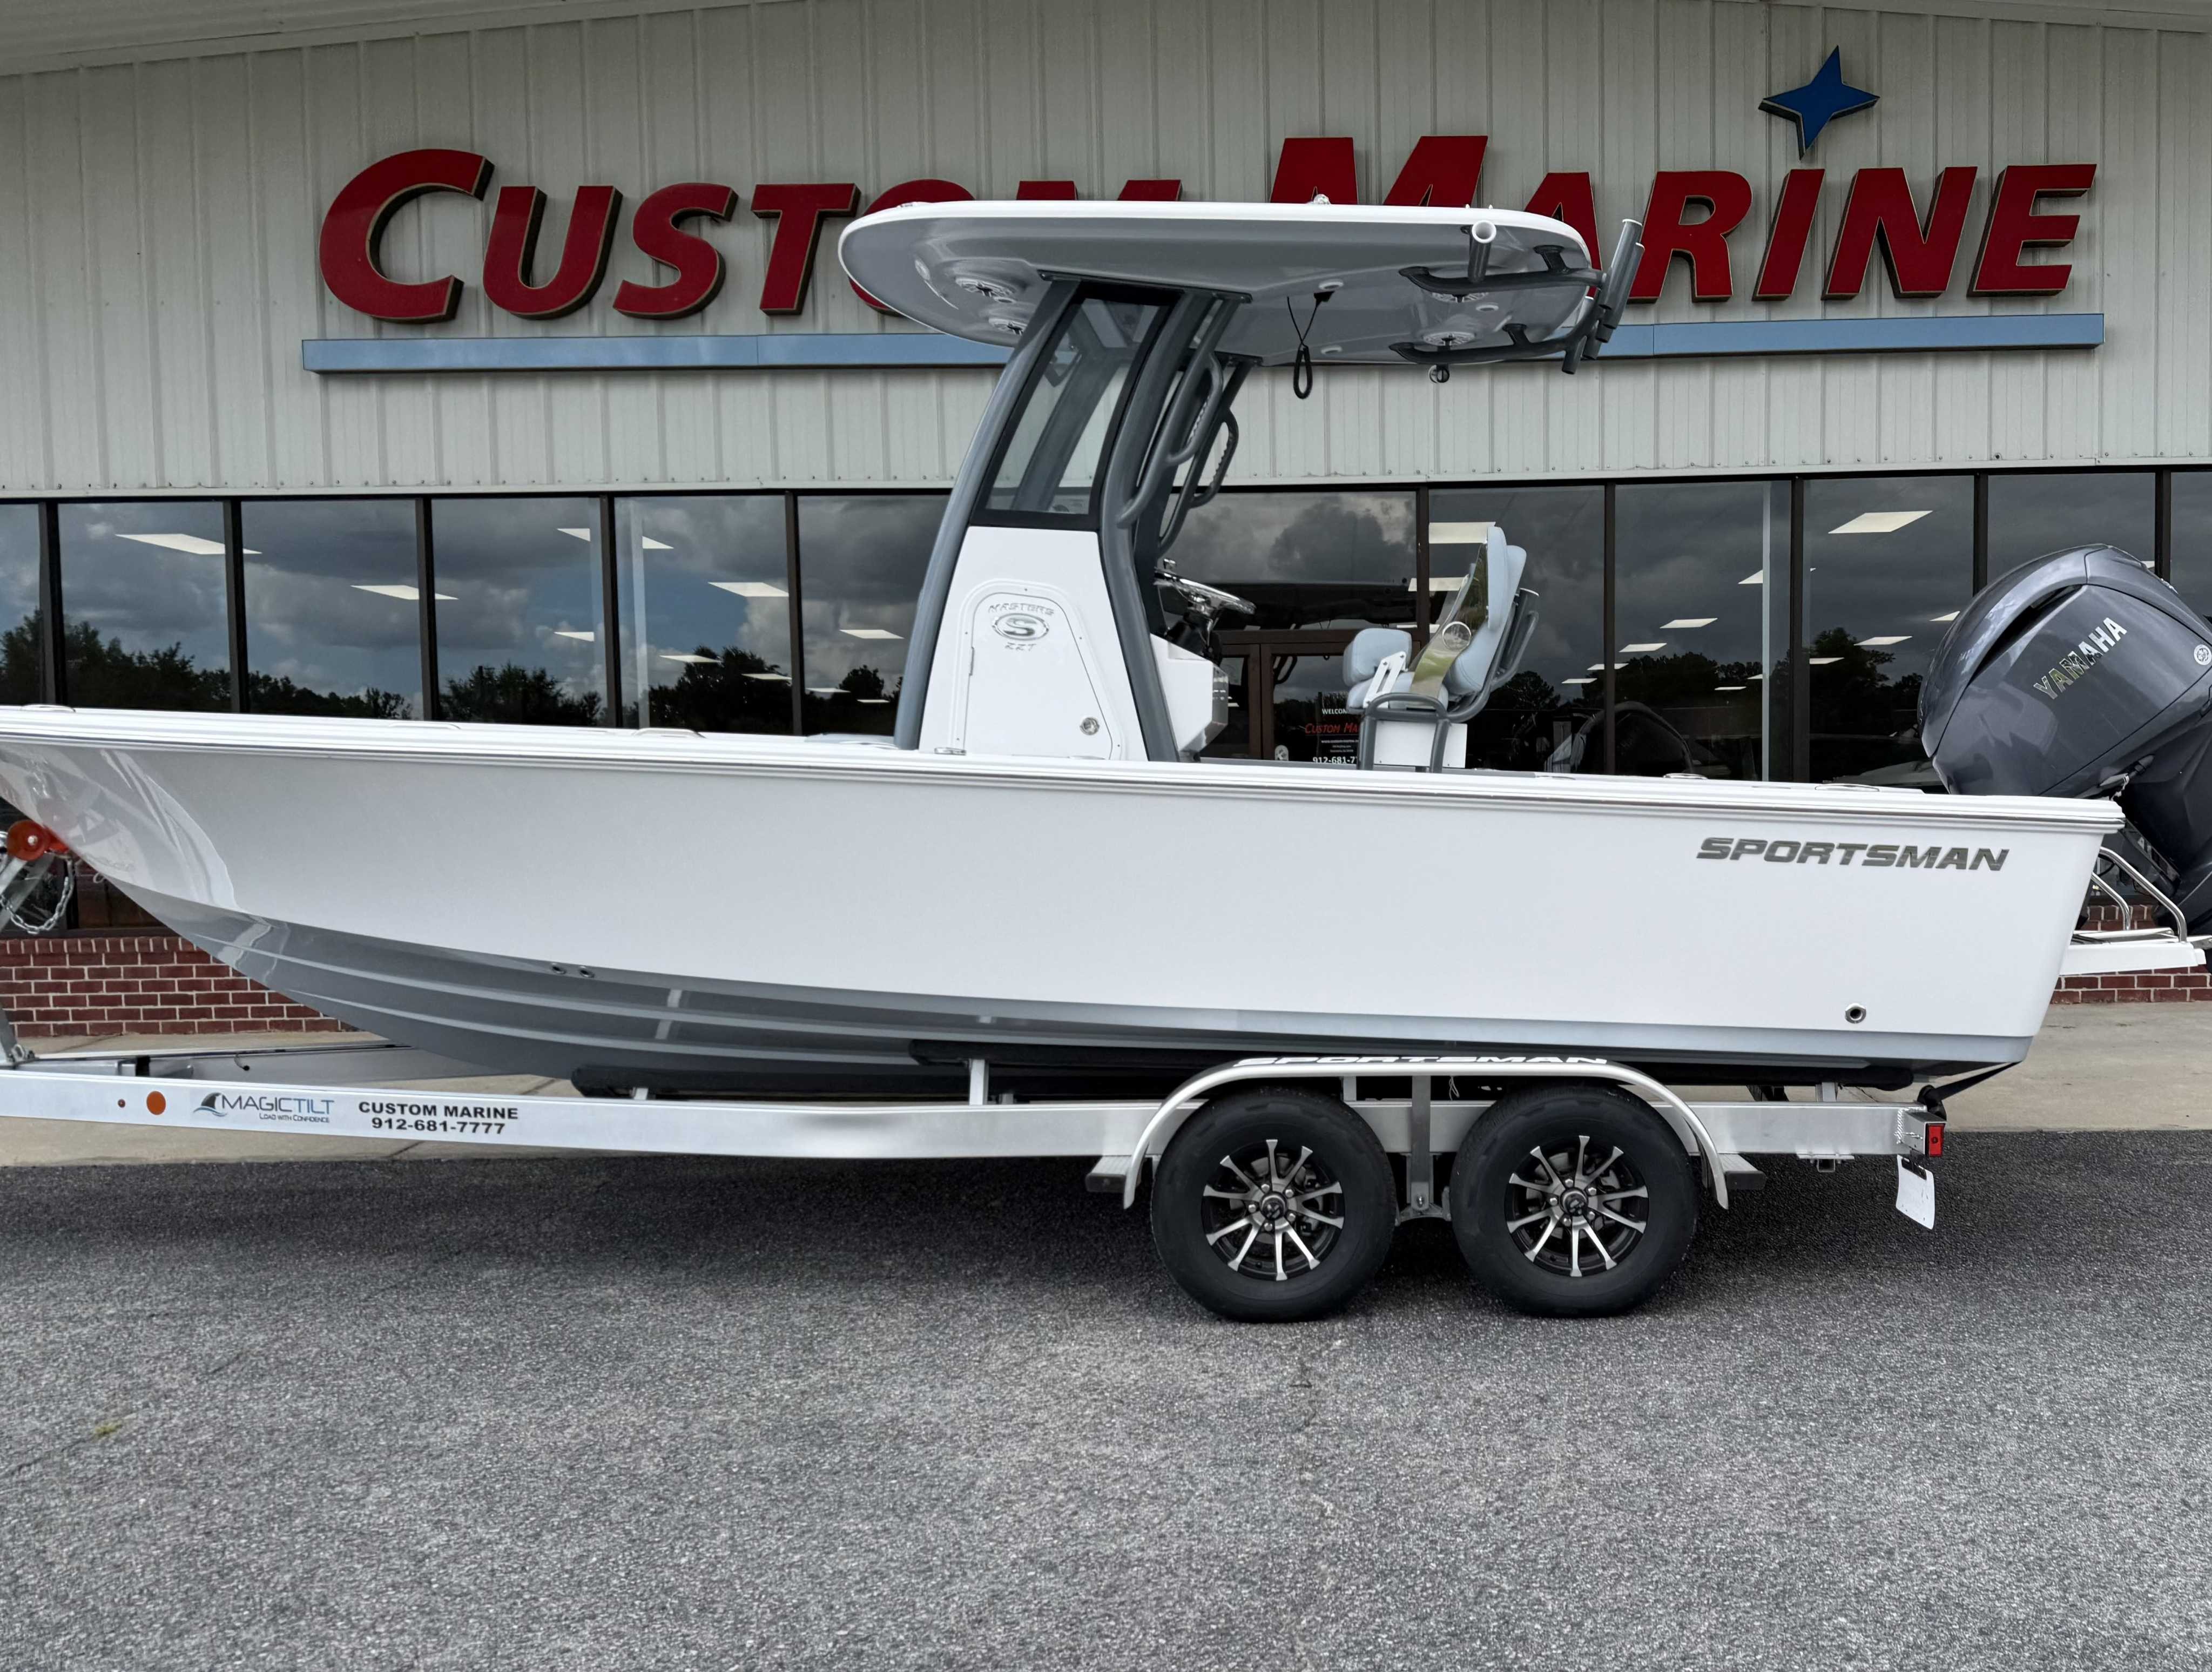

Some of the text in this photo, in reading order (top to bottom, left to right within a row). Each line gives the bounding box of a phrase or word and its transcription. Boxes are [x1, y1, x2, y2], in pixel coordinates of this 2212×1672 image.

[320, 149, 1182, 320] CUST
[2033, 617, 2127, 699] YAMAHA
[1305, 723, 1340, 733] CUSTOM
[1696, 837, 2009, 871] SPORTSMAN
[222, 1094, 334, 1114] MAGICTILT
[358, 1101, 518, 1120] CUSTOM MARINE
[372, 1117, 505, 1134] 912-681-7777
